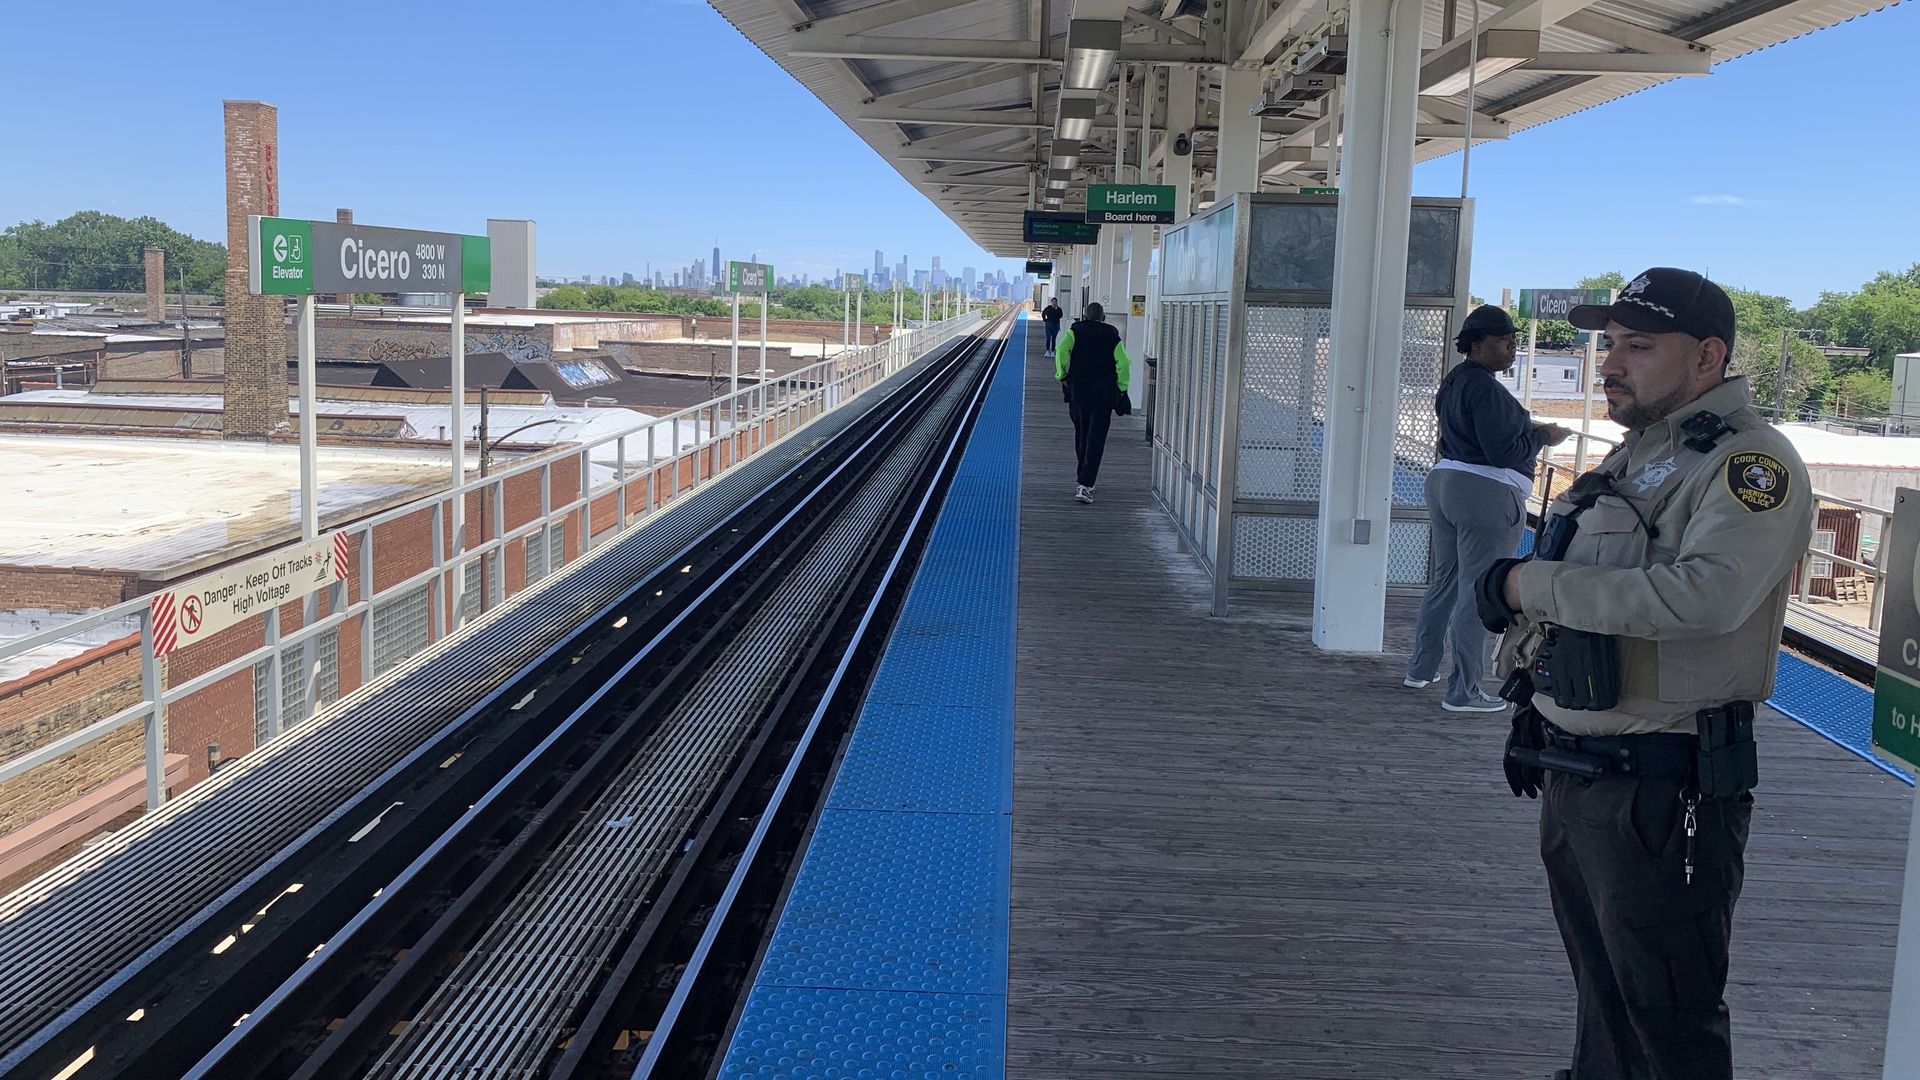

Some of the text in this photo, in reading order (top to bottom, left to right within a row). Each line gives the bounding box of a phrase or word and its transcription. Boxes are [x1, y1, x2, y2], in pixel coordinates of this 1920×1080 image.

[1106, 190, 1157, 205] Harlem
[1104, 212, 1157, 222] Board here
[340, 237, 411, 280] Cicero
[415, 243, 445, 260] 4800 W
[272, 265, 304, 279] Elevator
[422, 263, 445, 280] 330 N
[1540, 295, 1566, 314] Cicero
[1734, 455, 1786, 477] COOK COUNTY
[1737, 487, 1775, 504] SHERIFF'S
[1742, 494, 1770, 508] POLICE
[204, 584, 238, 607] Danger
[245, 573, 270, 590] Keep
[272, 564, 287, 580] Off
[288, 556, 313, 574] Tracks
[233, 582, 290, 615] High Voltage
[1891, 706, 1906, 730] to
